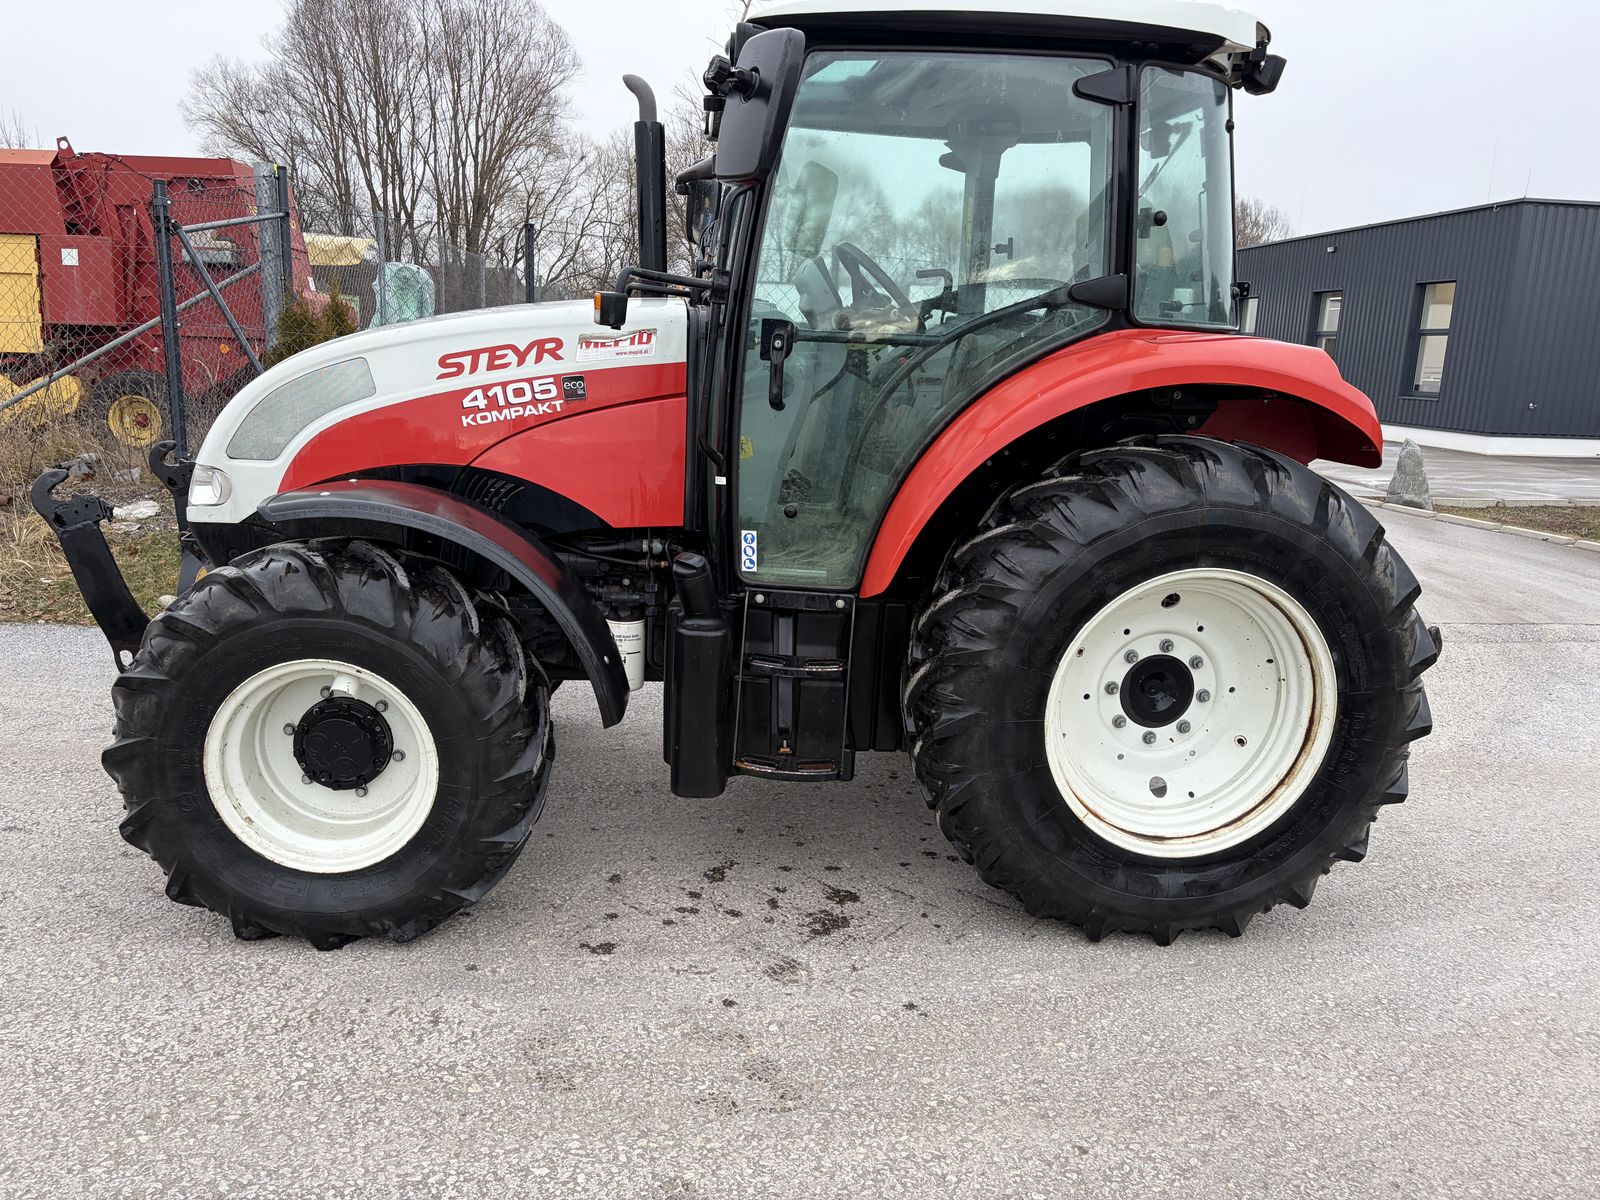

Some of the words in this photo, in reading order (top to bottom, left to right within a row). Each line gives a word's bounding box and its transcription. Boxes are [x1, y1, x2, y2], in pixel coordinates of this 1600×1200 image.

[436, 337, 565, 380] STEYR
[462, 377, 558, 410] 4105
[563, 381, 584, 390] eco
[461, 399, 564, 428] KOMPAKT
